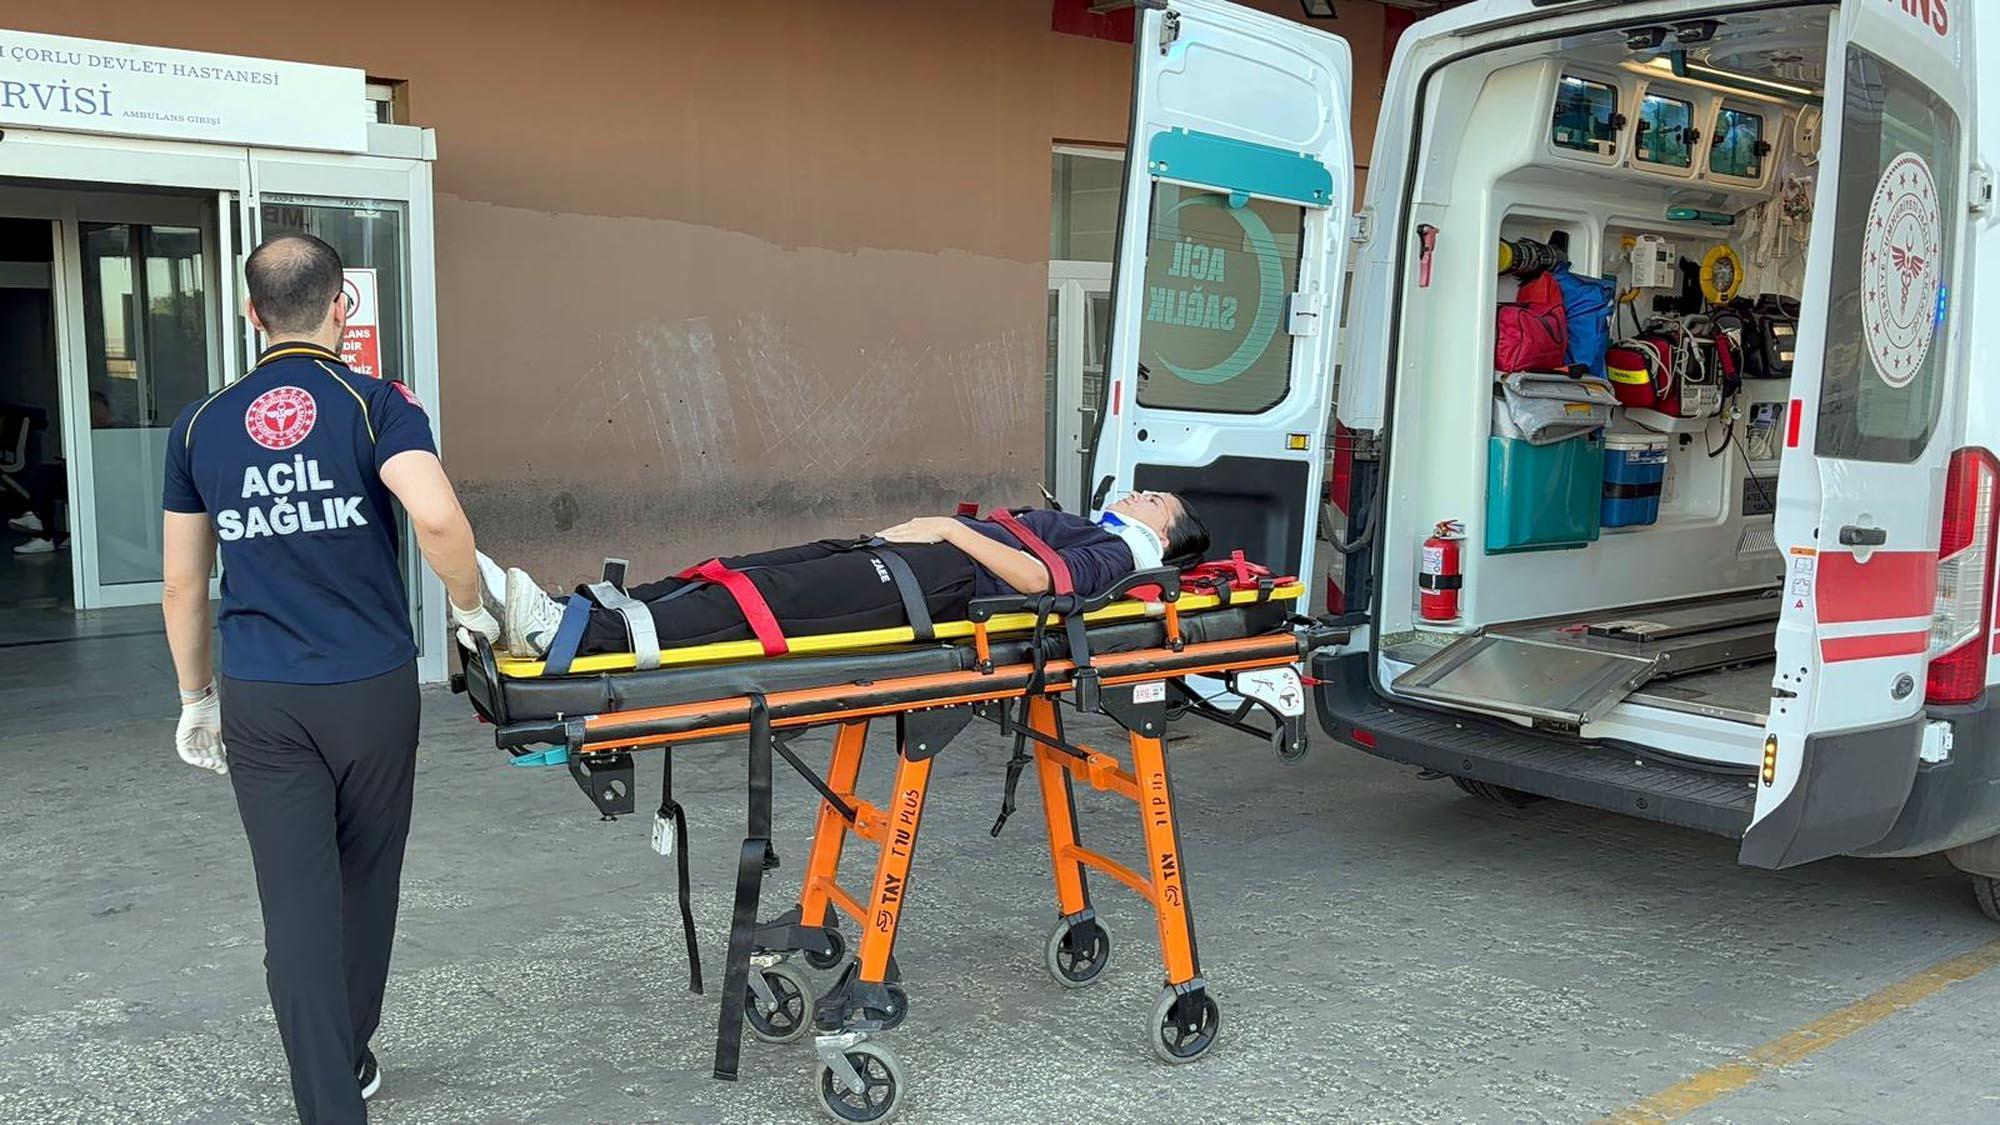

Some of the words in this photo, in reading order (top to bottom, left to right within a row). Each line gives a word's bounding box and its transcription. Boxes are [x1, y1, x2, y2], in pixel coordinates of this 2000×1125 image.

[11, 46, 82, 65] ÇORLU
[88, 54, 167, 73] DEVLET
[173, 63, 279, 85] HASTANESİ
[0, 78, 113, 116] RVİSİ
[122, 110, 185, 122] AMBULANS
[241, 453, 334, 498] ACİL
[216, 496, 368, 541] SAĞLIK
[881, 873, 901, 904] TAY
